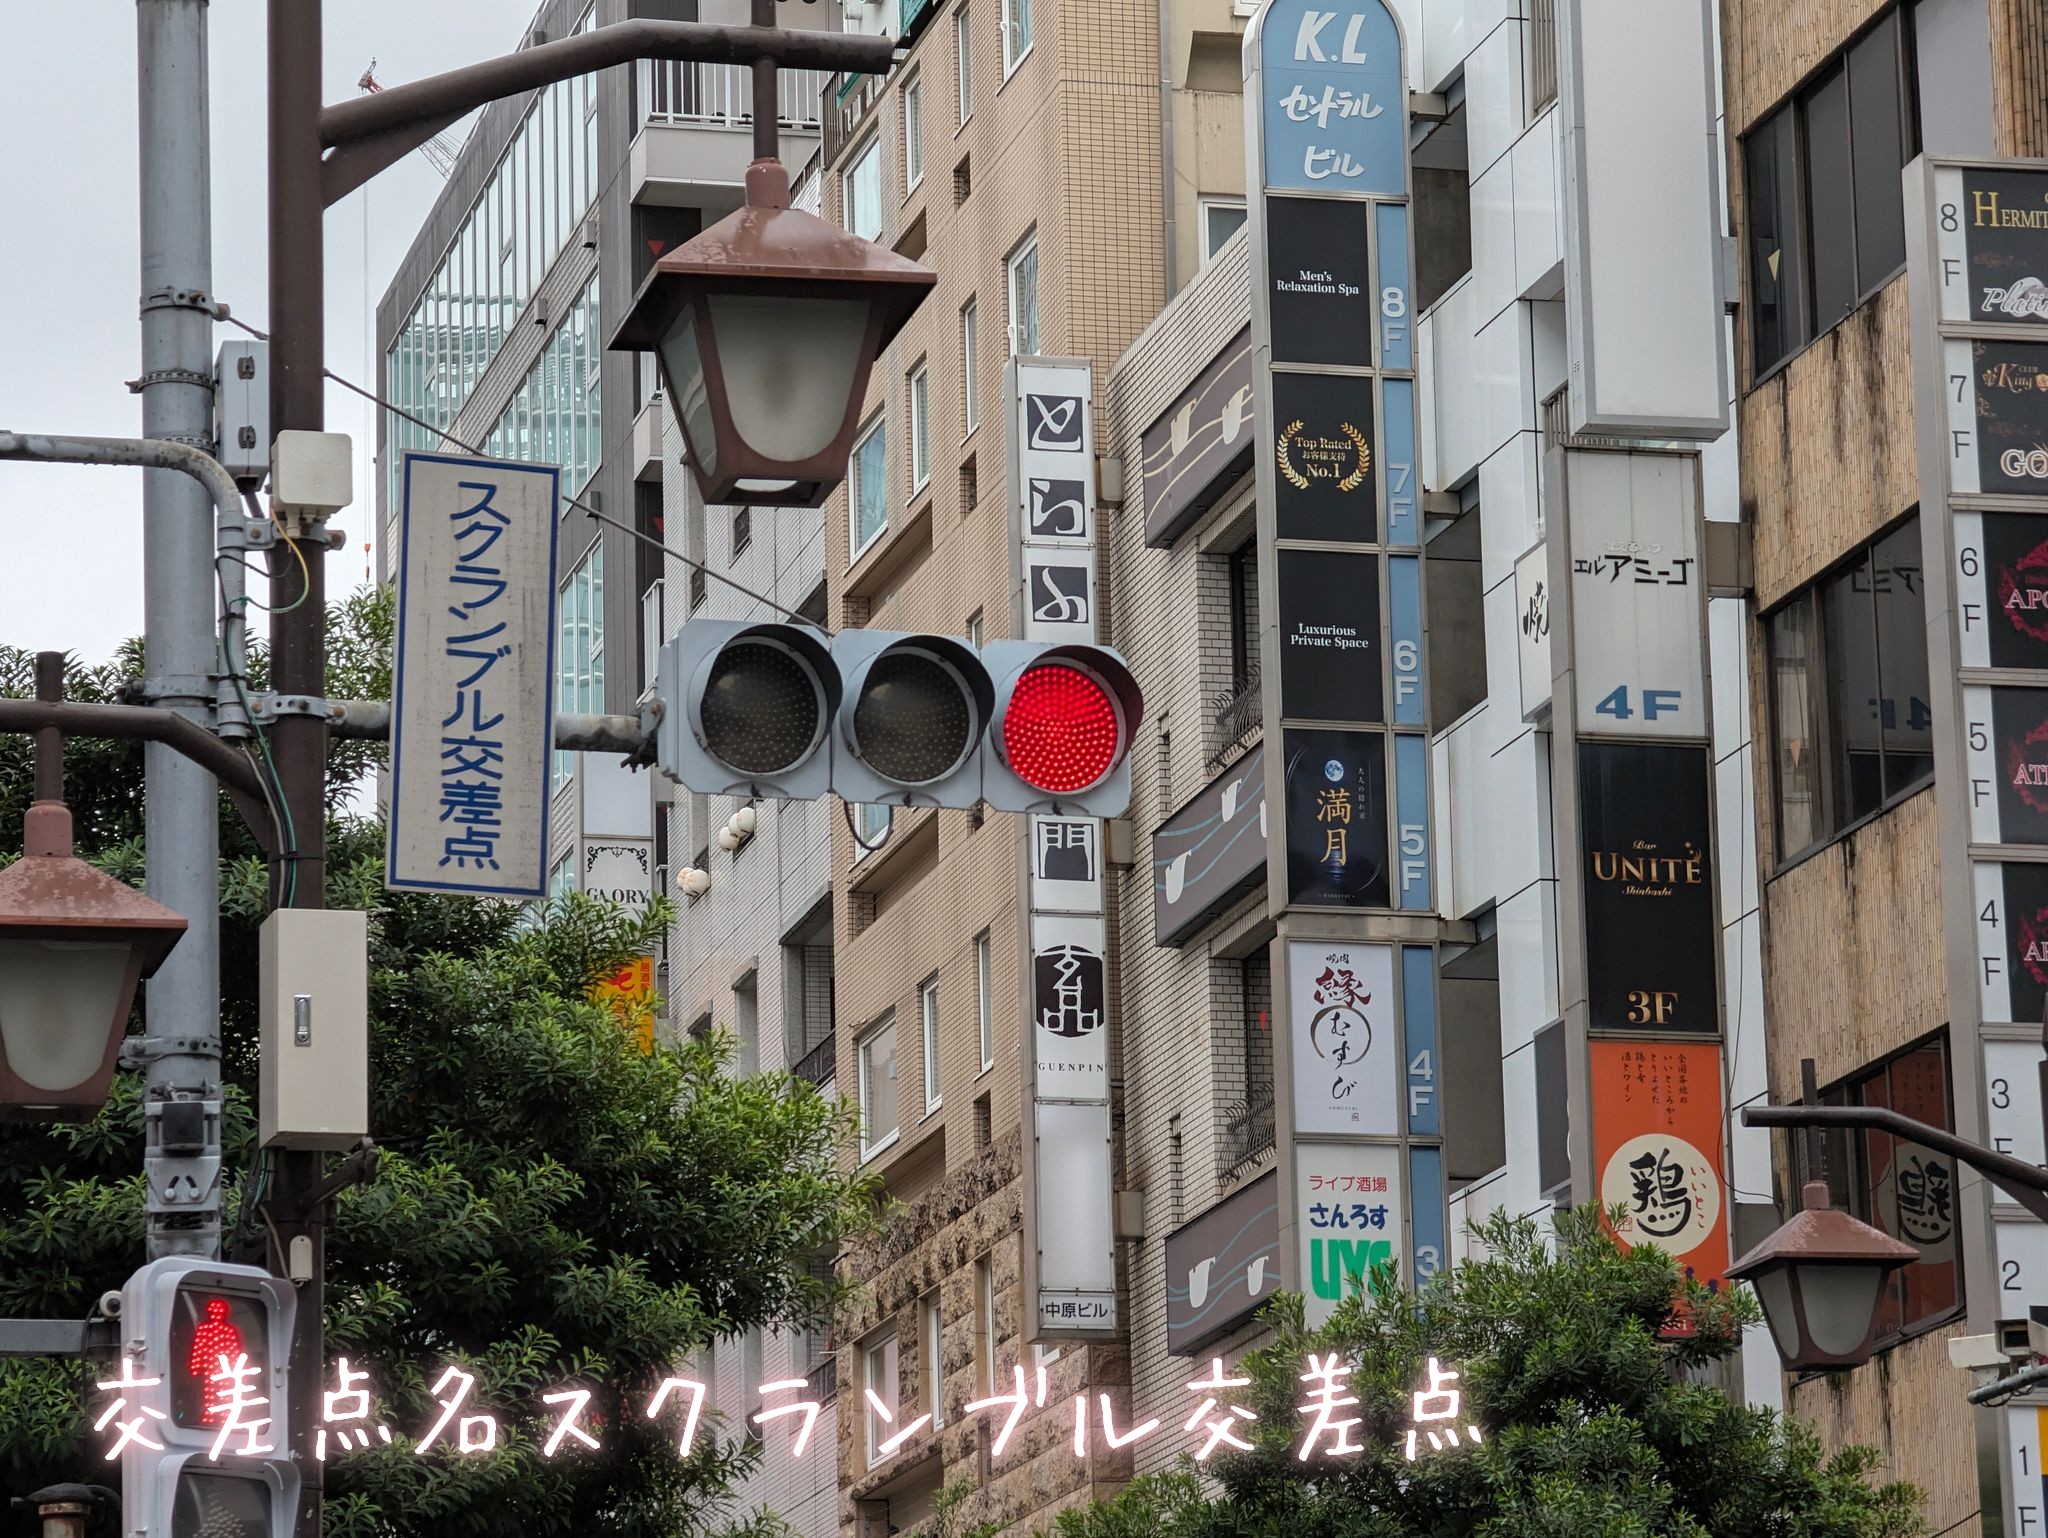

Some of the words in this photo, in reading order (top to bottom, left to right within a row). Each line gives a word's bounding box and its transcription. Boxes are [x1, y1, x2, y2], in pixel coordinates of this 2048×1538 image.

[1295, 10, 1367, 65] K.L
[1279, 85, 1384, 129] セントラル
[1304, 145, 1365, 180] ビル
[1276, 280, 1336, 294] Relaxation
[1338, 283, 1359, 297] Spa
[1299, 270, 1332, 282] Men's
[1294, 436, 1317, 450] Top
[1320, 437, 1352, 450] Rated
[1306, 463, 1342, 478] No.1
[1574, 554, 1694, 585] エルアミーゴ
[1290, 634, 1332, 647] Private
[1334, 636, 1369, 650] Space
[1298, 623, 1356, 636] Luxurious
[438, 481, 512, 871] スクランブル交差点
[1595, 684, 1682, 721] 4F
[1316, 787, 1351, 867] 満月
[1632, 839, 1657, 851] Bar
[1622, 884, 1673, 897] Shinbashi
[1037, 944, 1103, 1033] 玄品
[1627, 990, 1679, 1025] 3F
[1038, 1062, 1105, 1073] GUENPIN
[1309, 1175, 1388, 1193] ライブ酒場
[1629, 1147, 1693, 1238] 鶏
[1689, 1165, 1707, 1229] いいとこ
[1309, 1202, 1389, 1231] さんろす
[1045, 1301, 1108, 1319] 中原ビル
